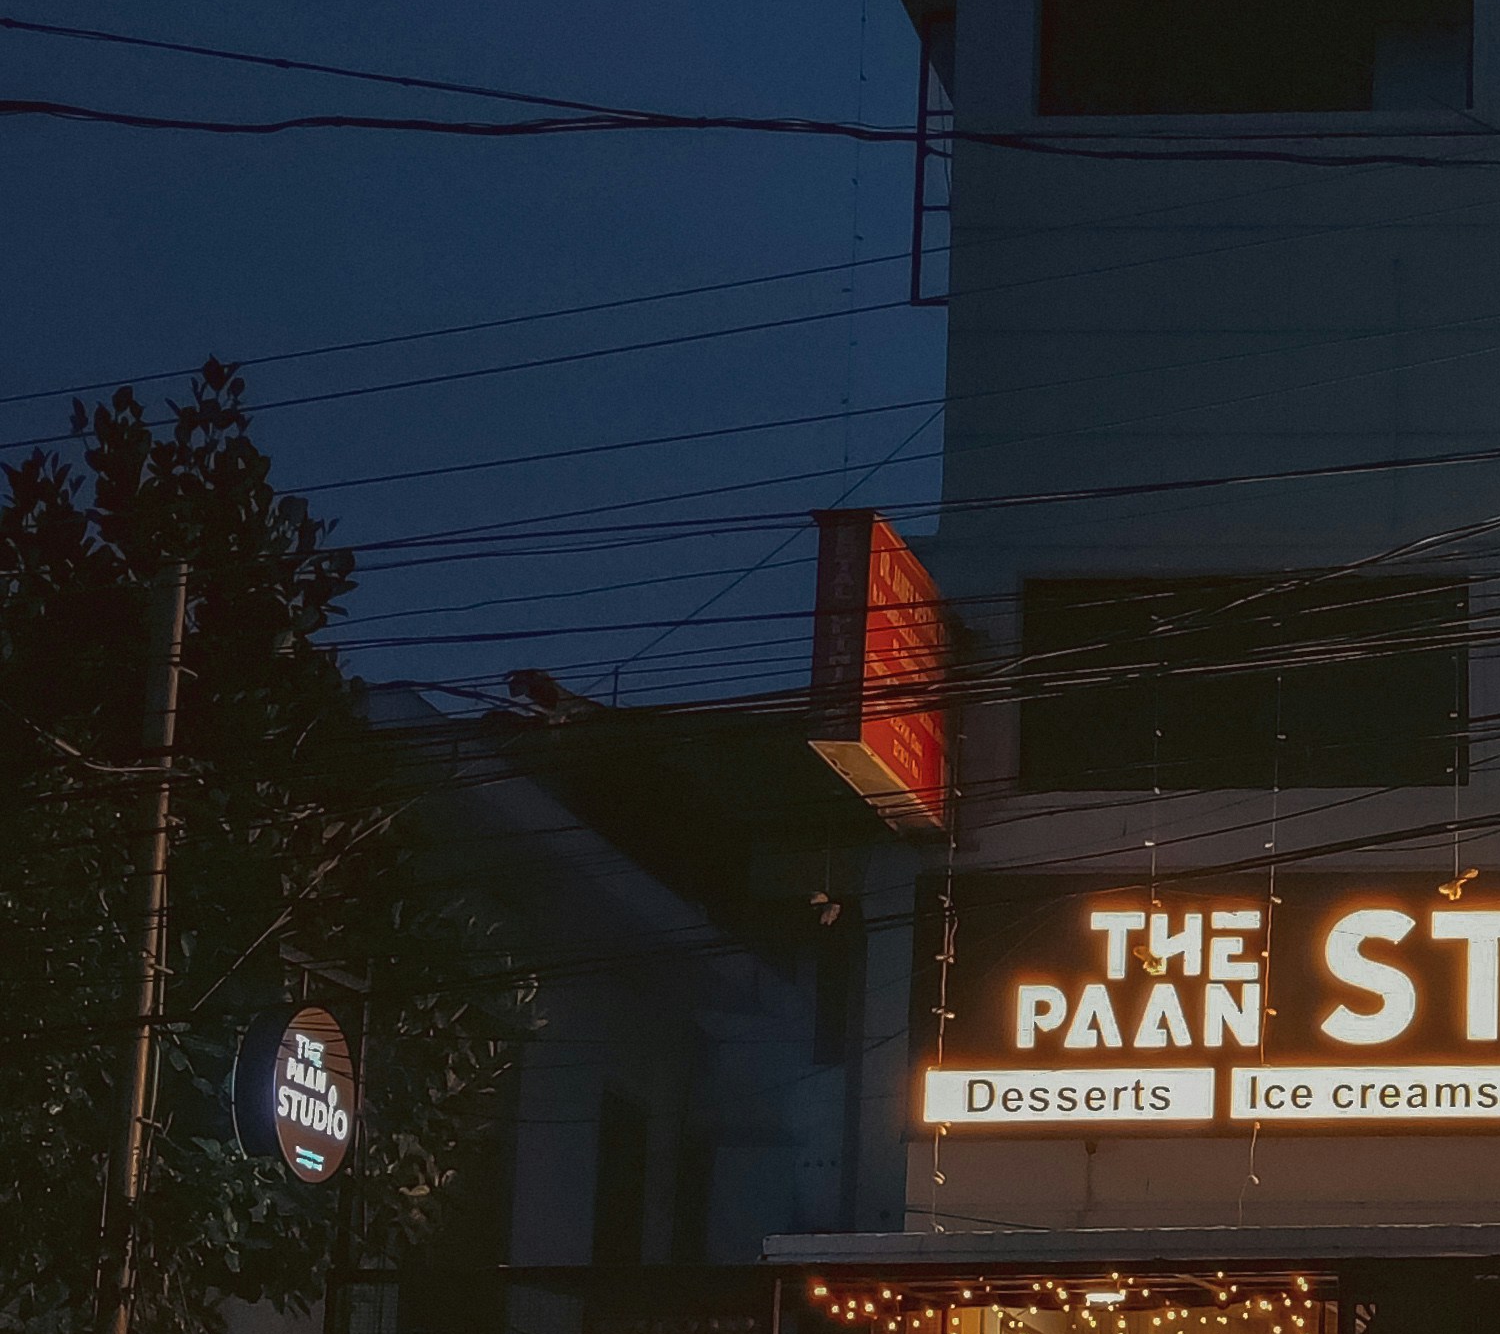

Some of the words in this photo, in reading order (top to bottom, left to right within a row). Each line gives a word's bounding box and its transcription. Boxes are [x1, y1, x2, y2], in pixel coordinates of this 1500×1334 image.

[1090, 911, 1261, 981] THE
[1016, 983, 1260, 1049] PAAN
[286, 1056, 327, 1094] PAAN
[966, 1078, 1172, 1113] Desserts
[1249, 1075, 1313, 1110] Ice
[1331, 1083, 1499, 1110] creams
[277, 1084, 349, 1141] STUDIO
